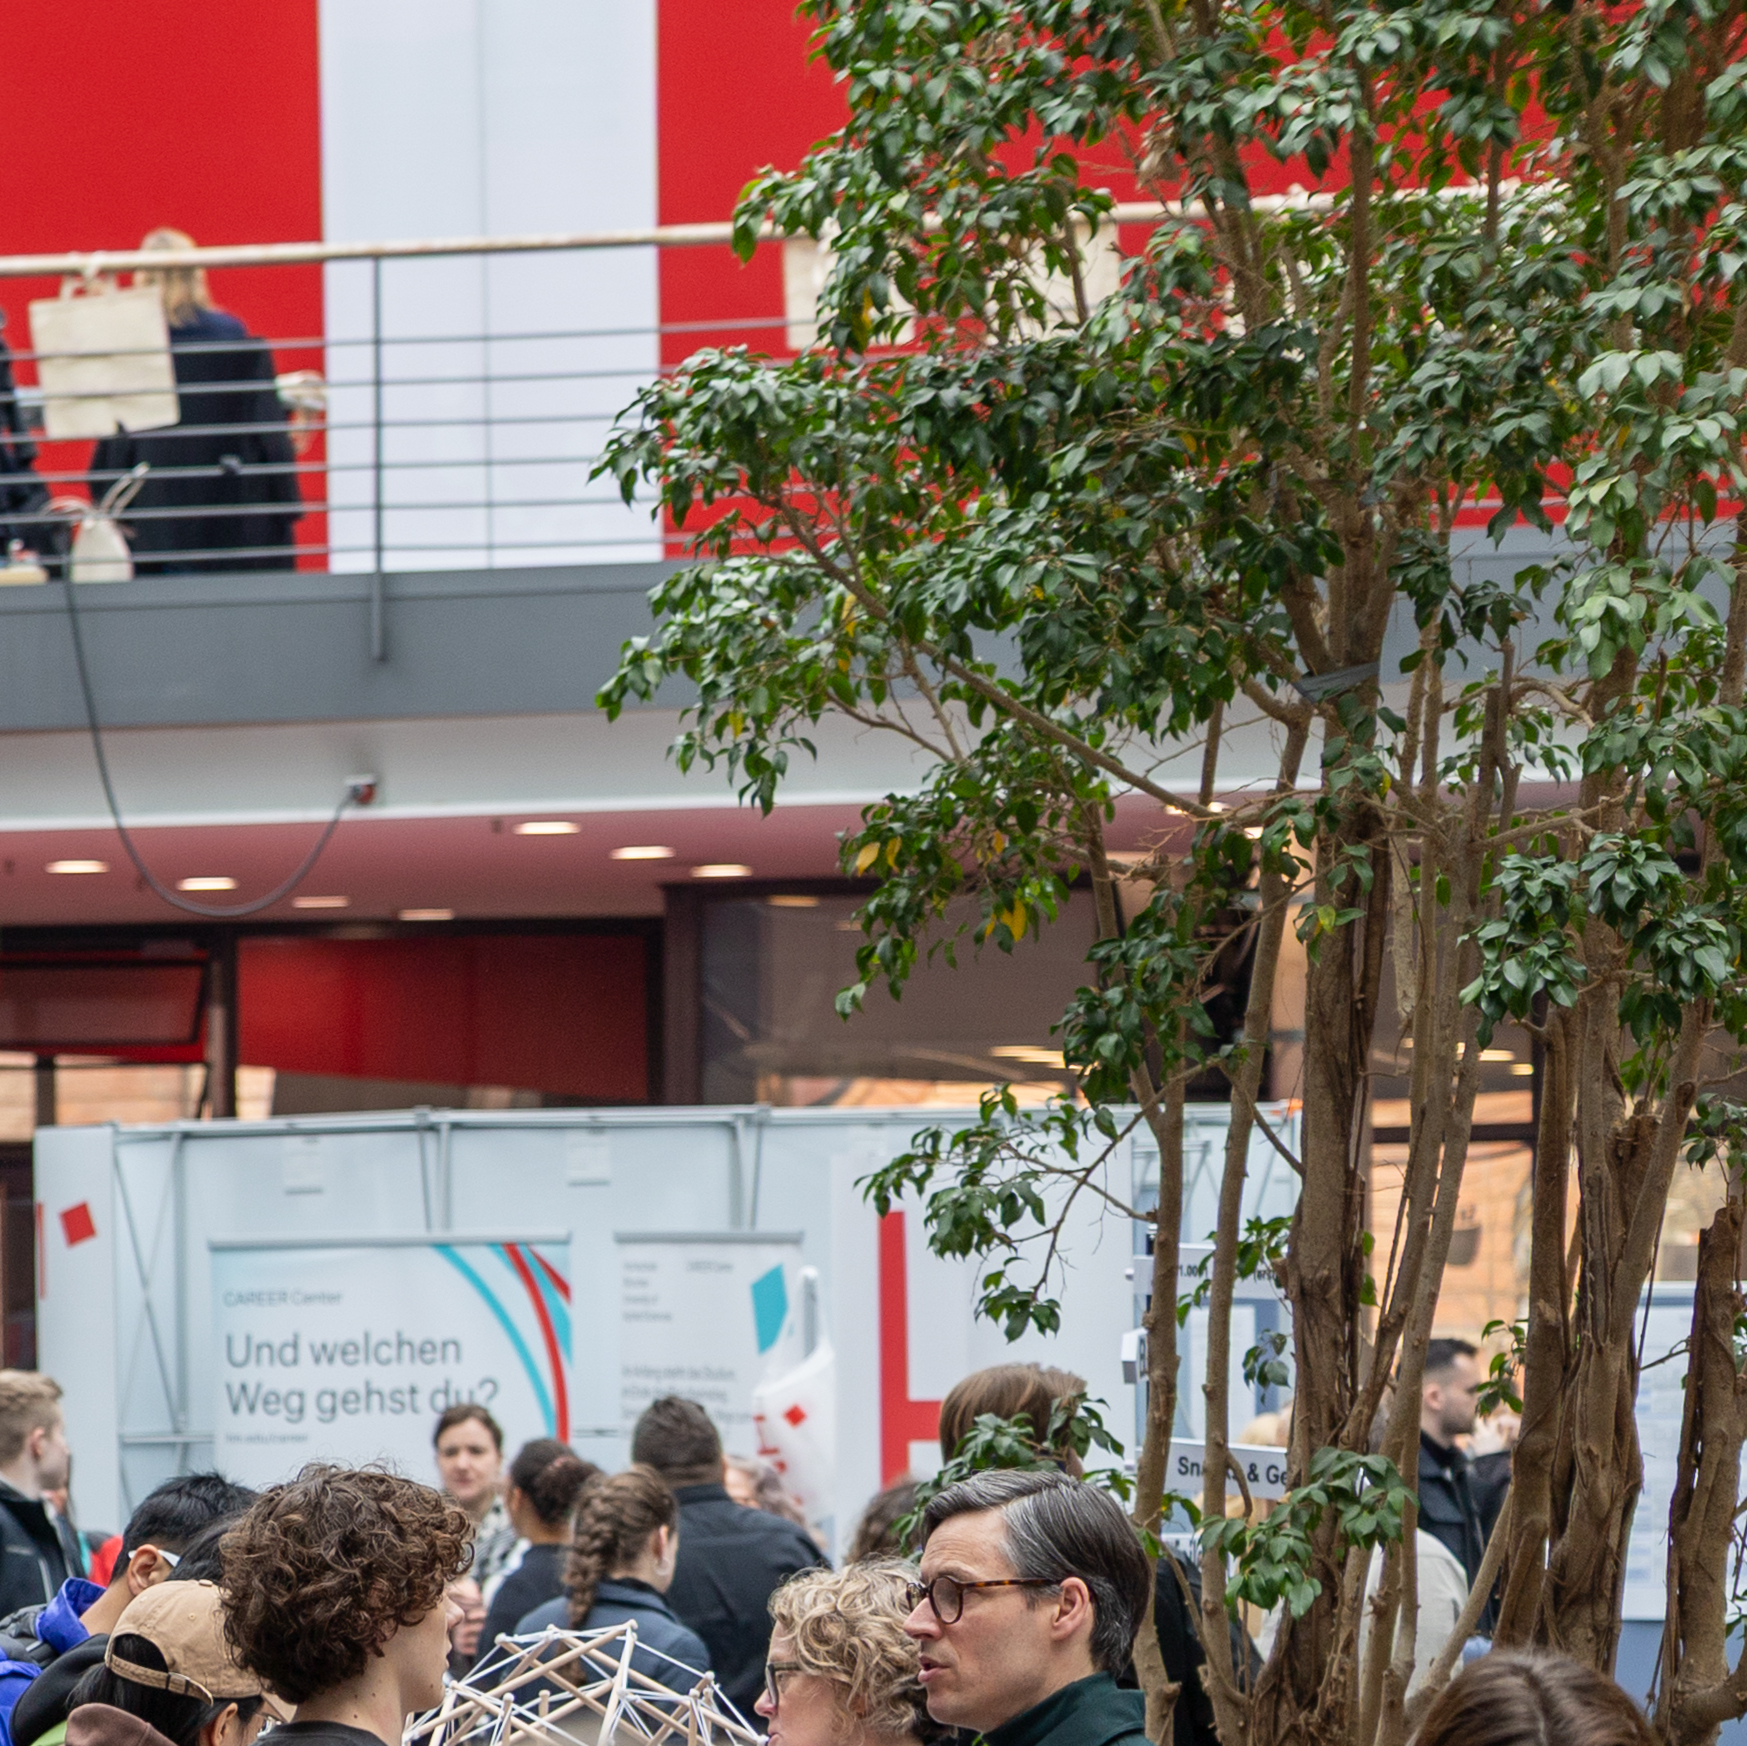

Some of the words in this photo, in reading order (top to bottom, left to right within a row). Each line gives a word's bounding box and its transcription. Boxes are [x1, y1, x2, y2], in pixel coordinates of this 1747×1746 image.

[225, 1331, 300, 1369] Und
[308, 1329, 462, 1367] welchen
[225, 1381, 306, 1424] Weg
[315, 1379, 420, 1424] gehst
